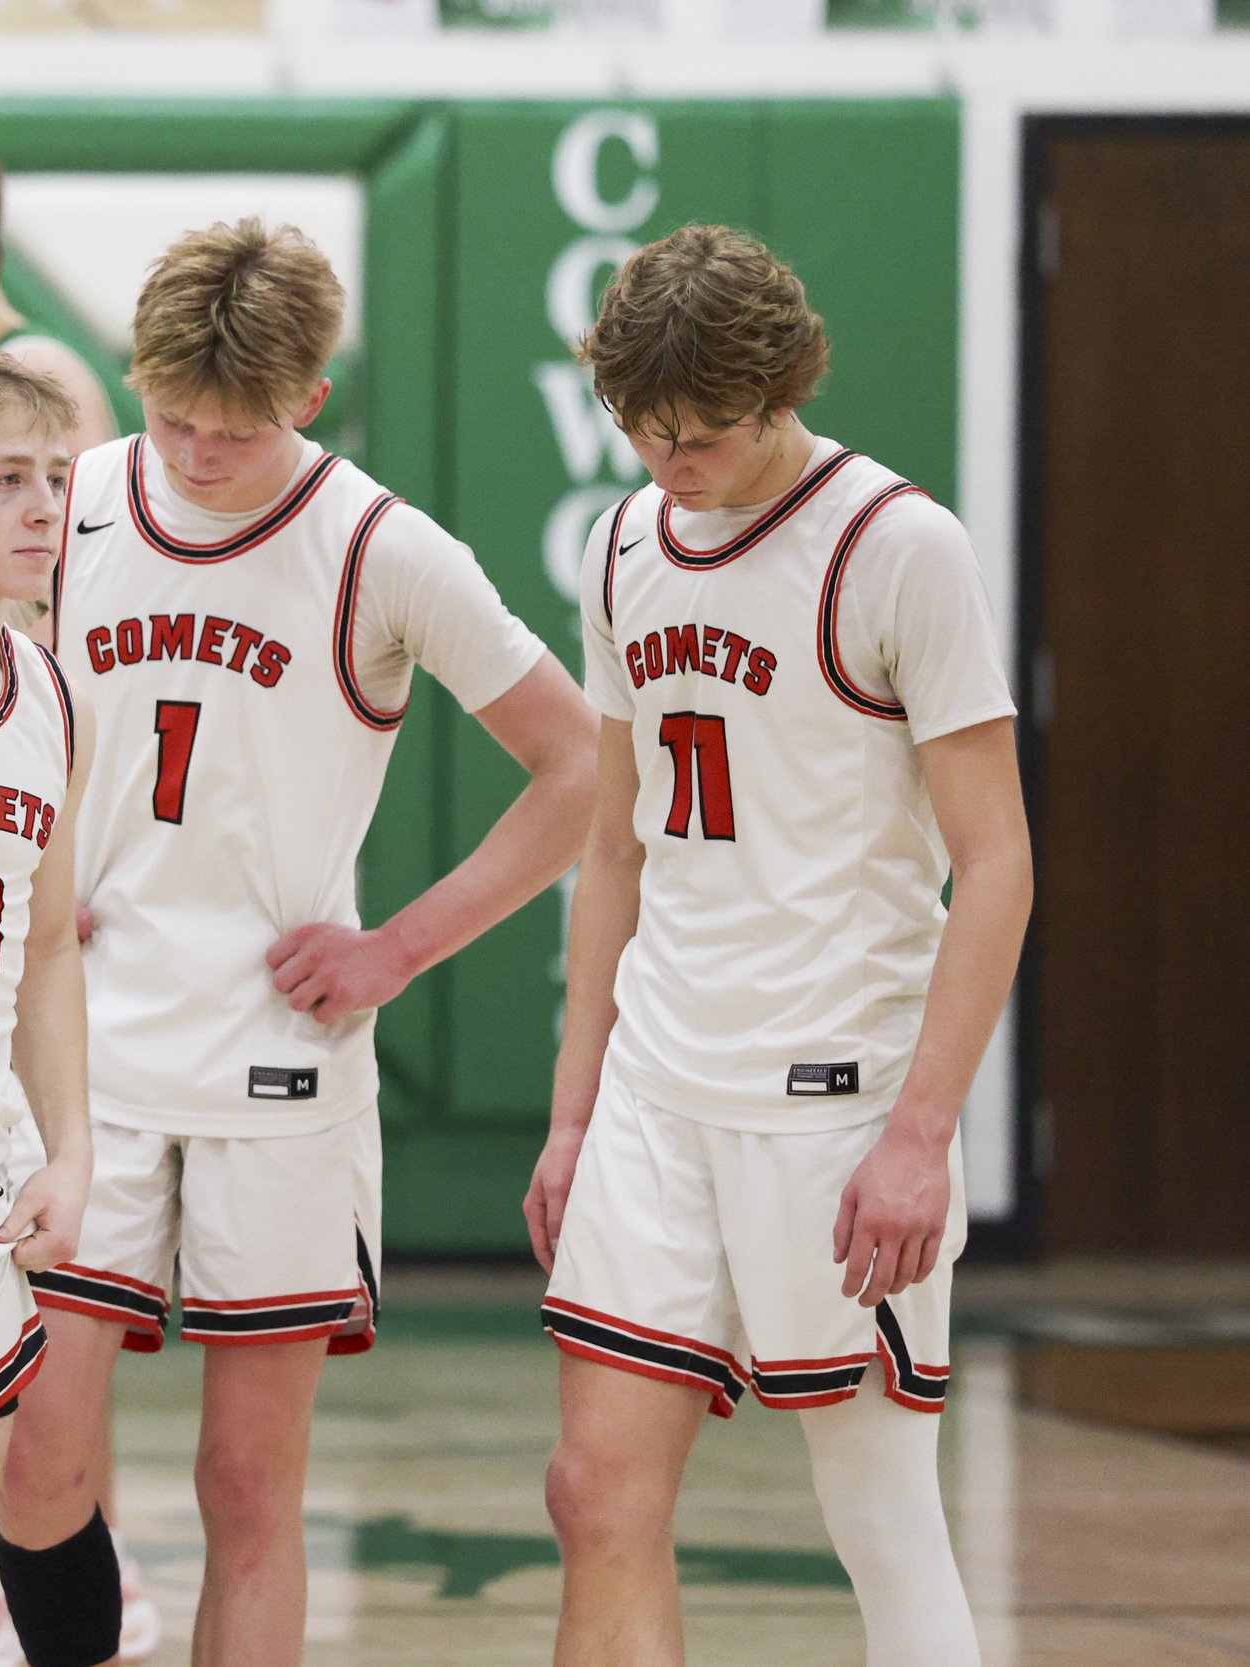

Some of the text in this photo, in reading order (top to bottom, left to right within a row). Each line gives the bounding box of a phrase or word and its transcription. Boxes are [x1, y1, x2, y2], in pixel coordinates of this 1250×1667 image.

[86, 613, 292, 689] COMETS
[626, 623, 778, 697] COMETS
[152, 699, 202, 826] 1
[659, 710, 736, 843] 11
[296, 1079, 309, 1091] M
[836, 1073, 848, 1086] M
